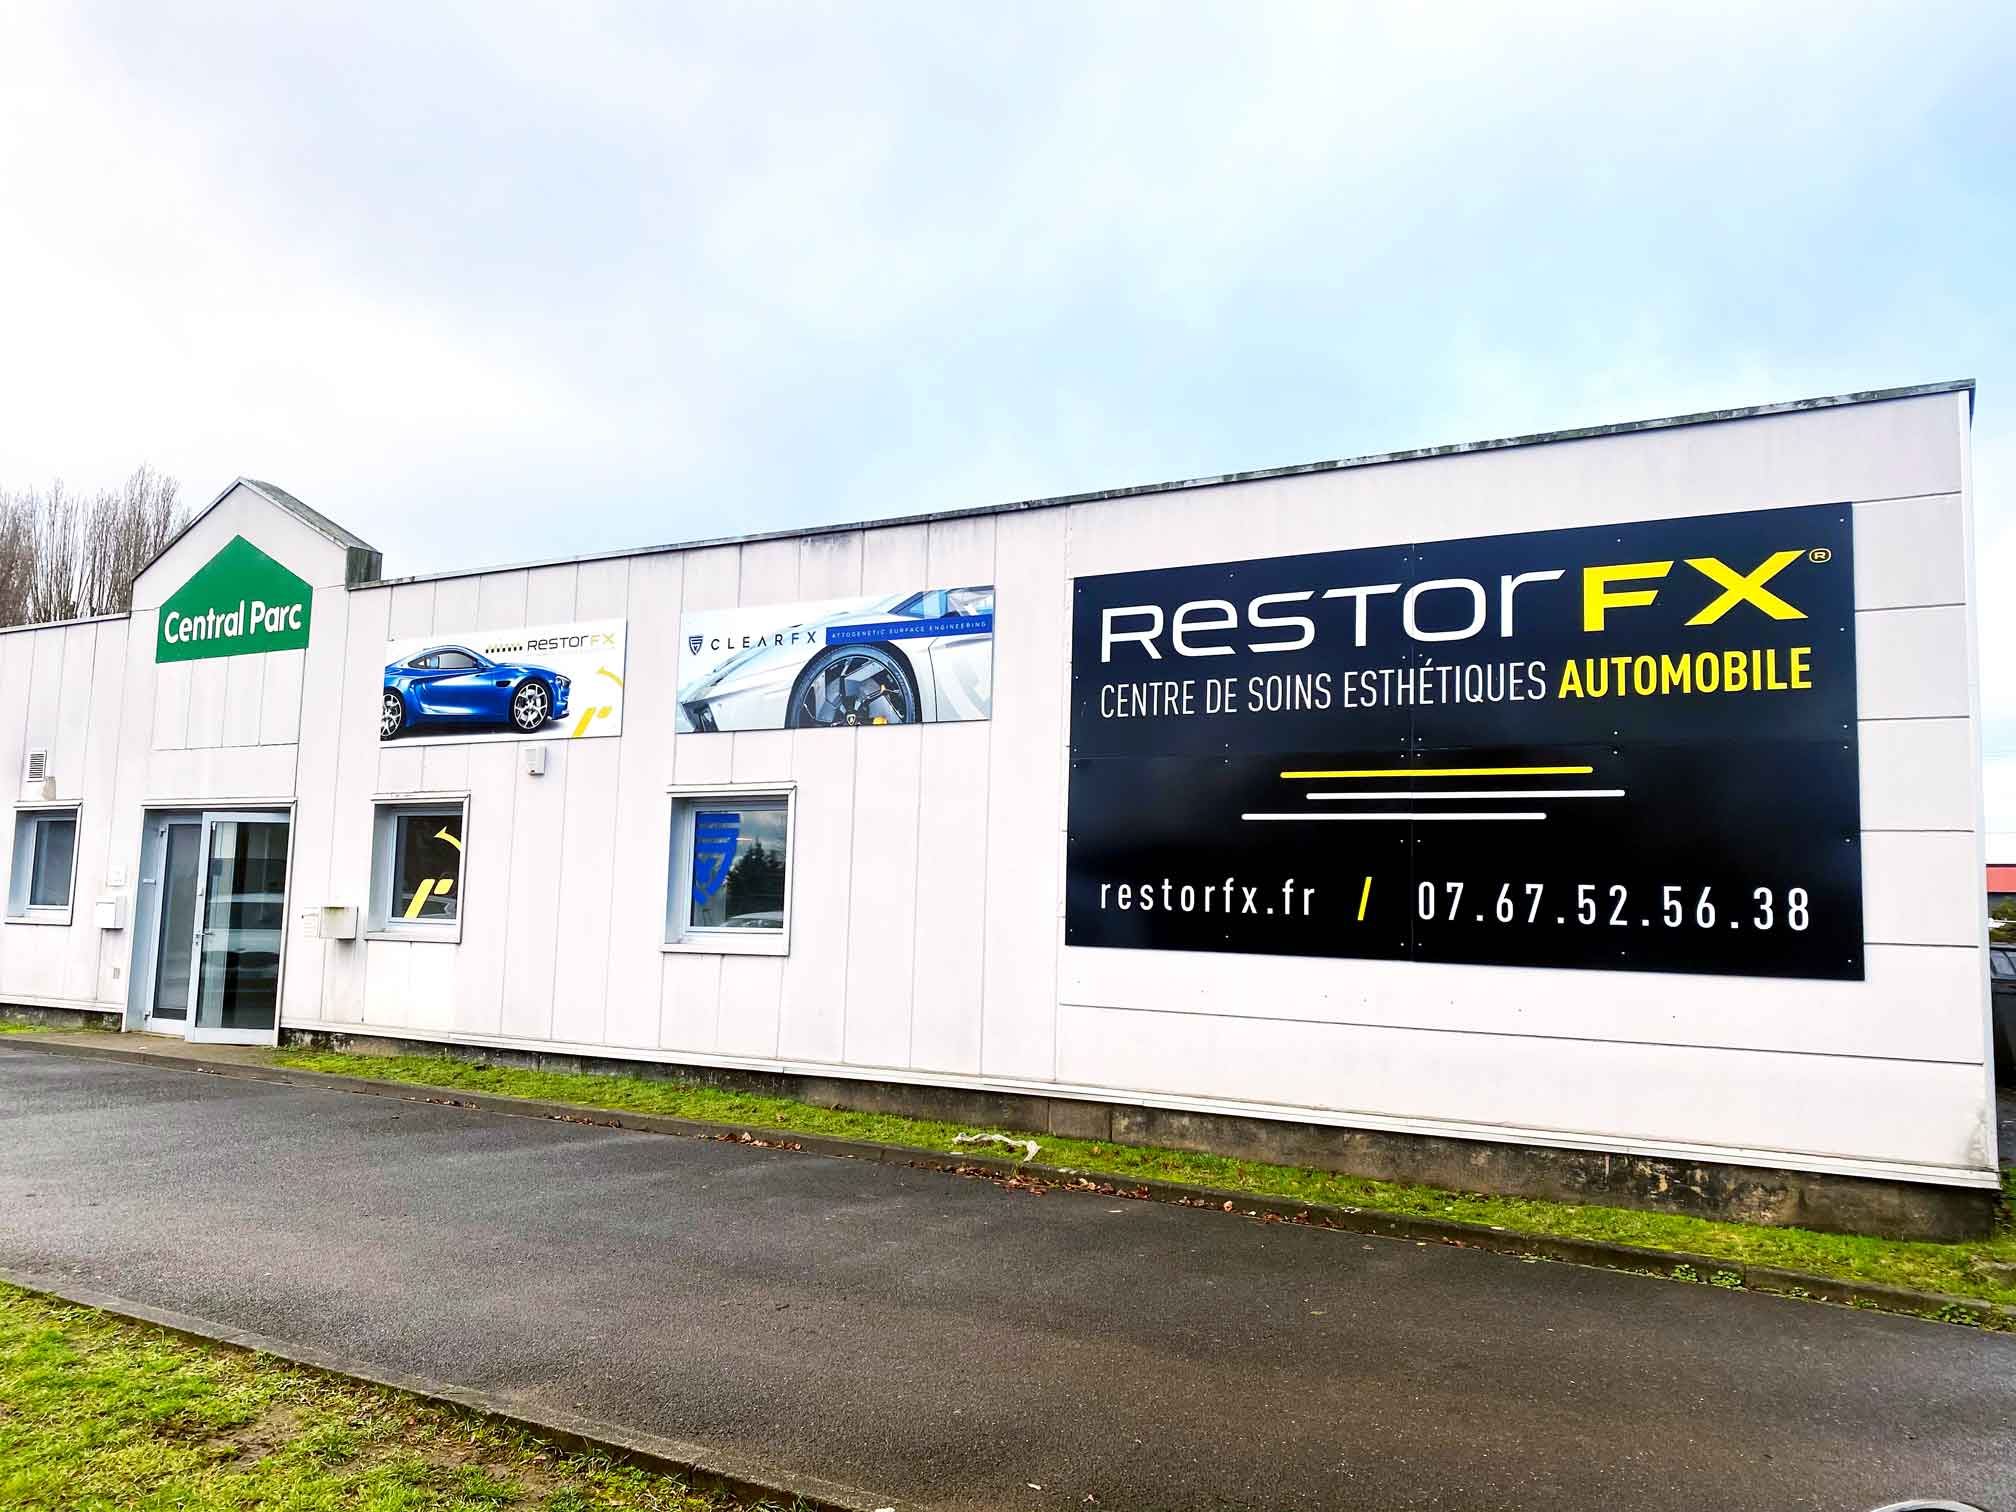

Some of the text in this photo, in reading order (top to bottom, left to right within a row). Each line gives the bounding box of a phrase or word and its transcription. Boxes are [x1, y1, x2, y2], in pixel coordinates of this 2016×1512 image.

[164, 599, 303, 643] Central Parc
[710, 631, 817, 651] CLEARFX
[1101, 646, 1813, 719] CENTRE DE SOINS ESTHÉTIQUES AUTOMOBILE
[1100, 878, 1317, 917] restorfx.fr
[1417, 881, 1809, 932] 07.67.52.56.38
